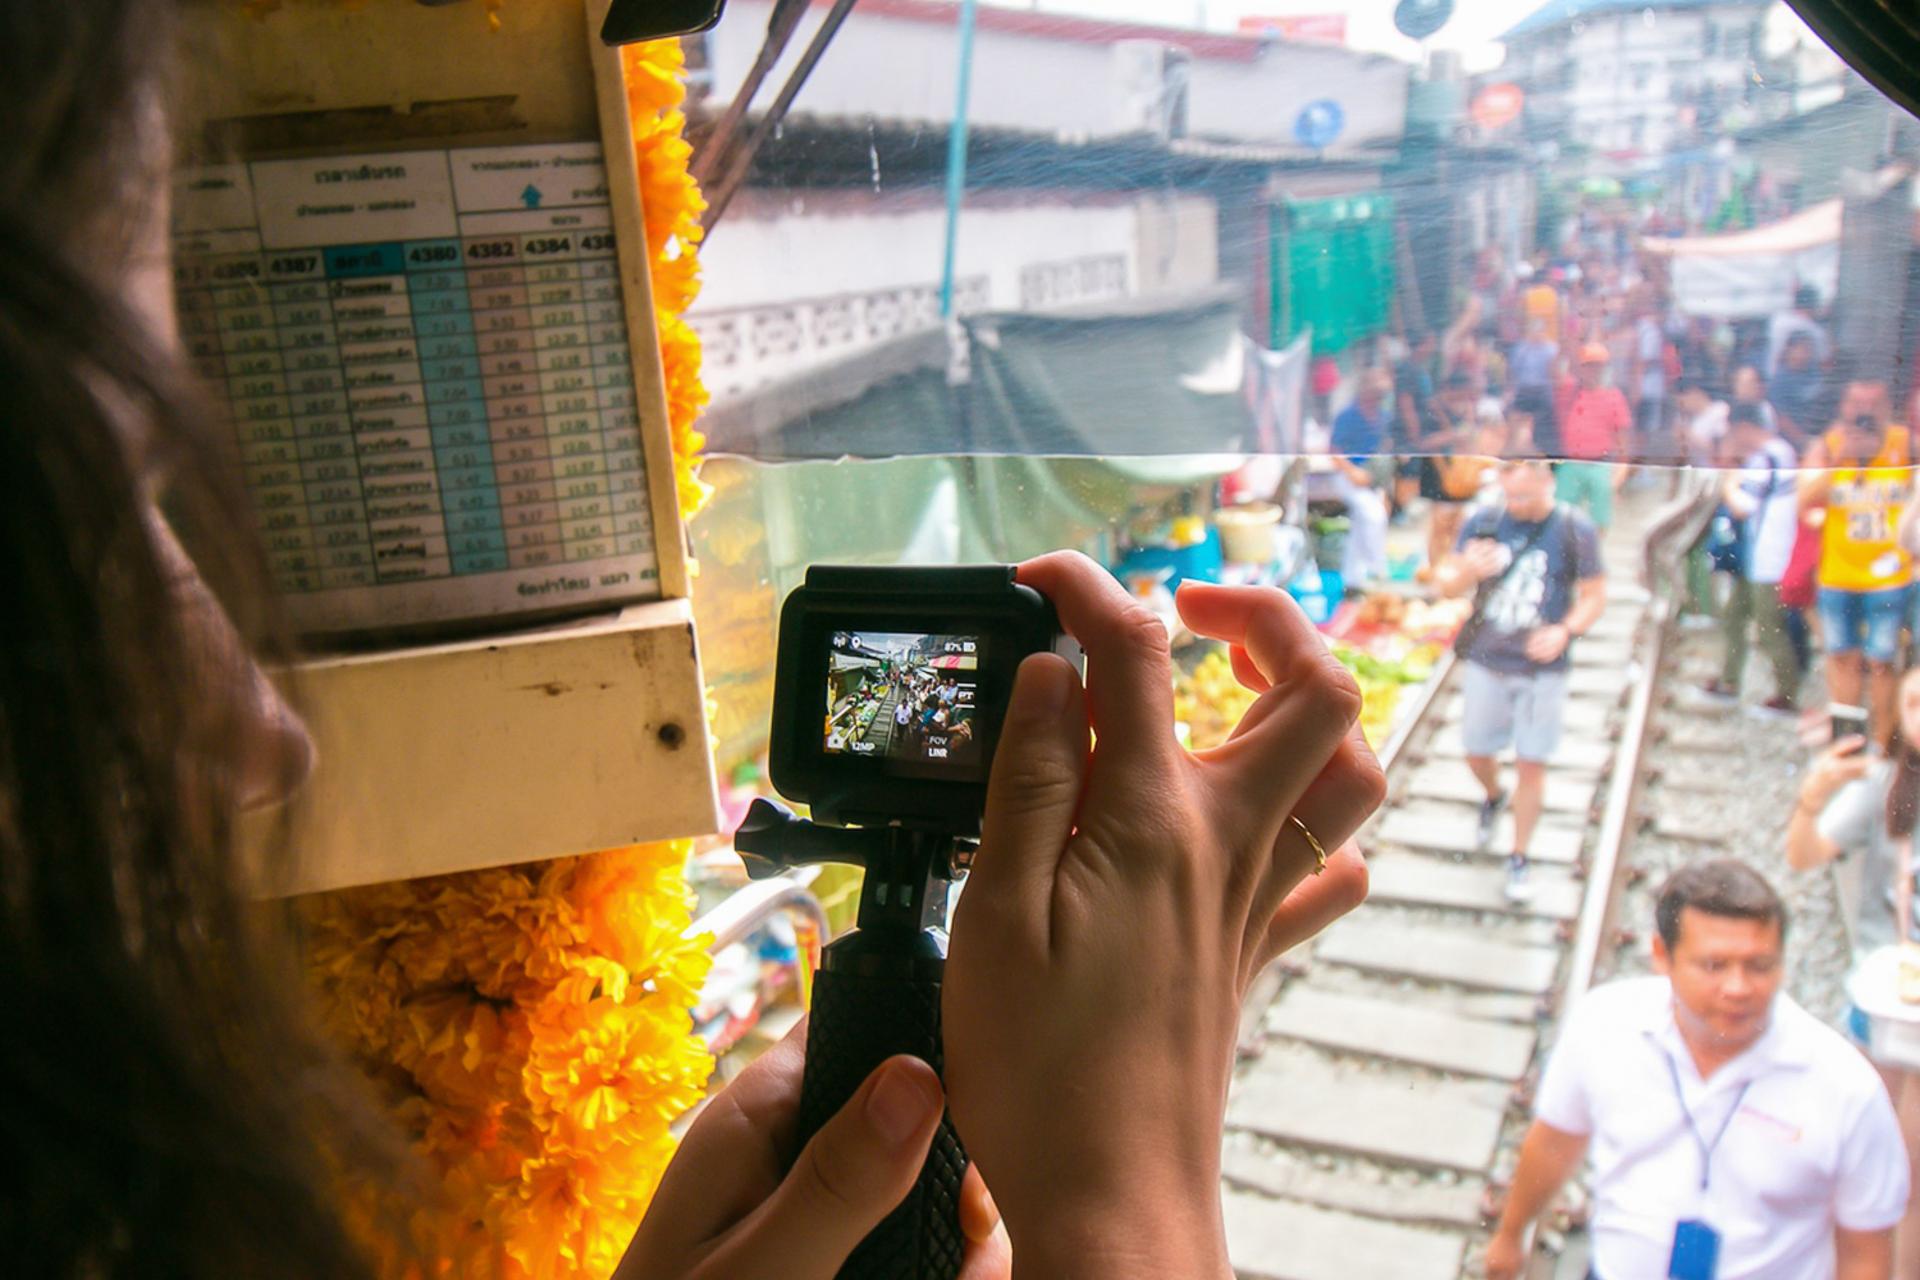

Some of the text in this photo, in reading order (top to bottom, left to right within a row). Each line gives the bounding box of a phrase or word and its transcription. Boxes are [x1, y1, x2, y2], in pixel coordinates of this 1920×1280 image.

[468, 241, 513, 258] 4382
[526, 237, 570, 254] 4384
[411, 246, 457, 263] 4380
[929, 735, 948, 745] FOV
